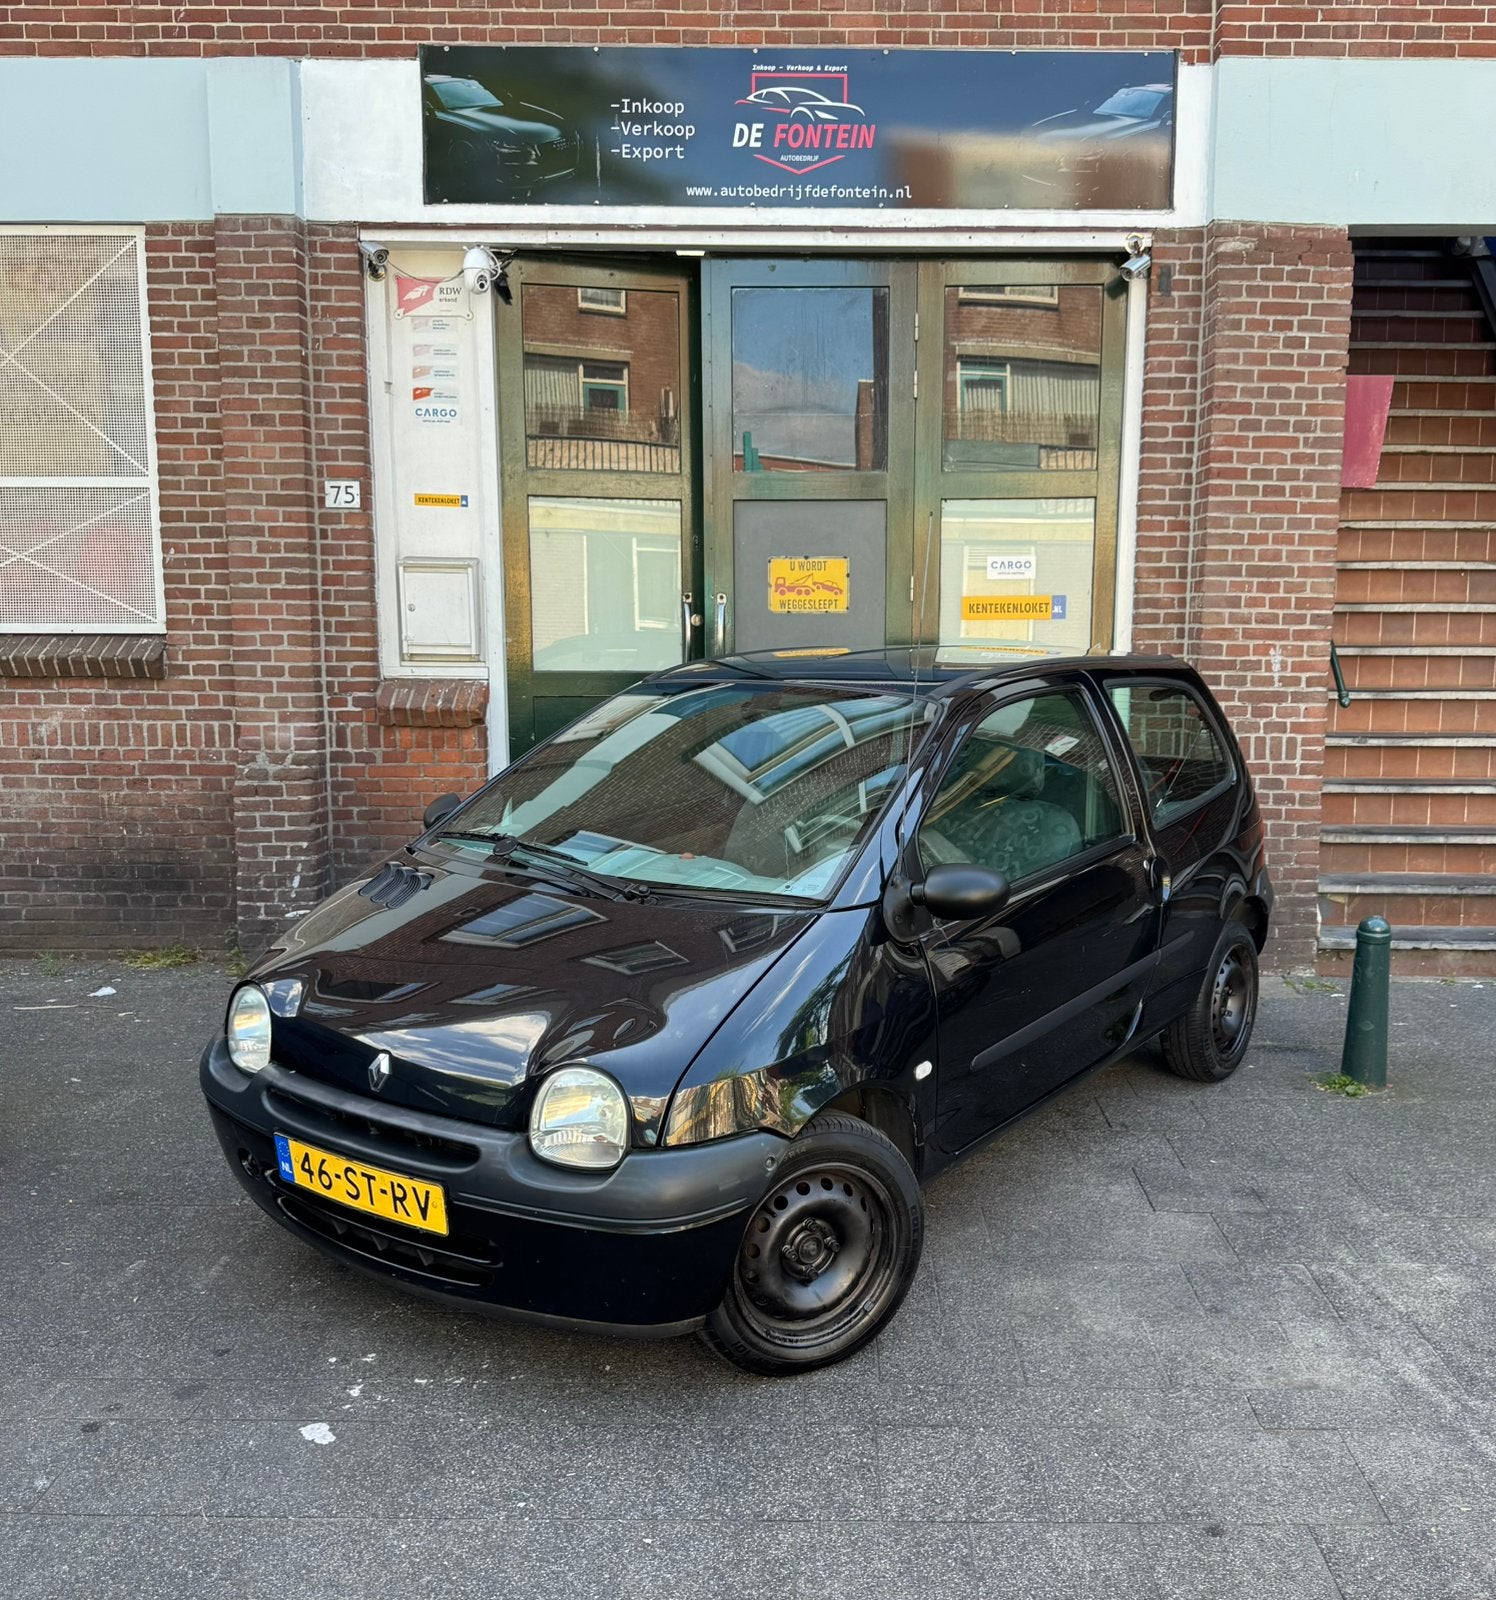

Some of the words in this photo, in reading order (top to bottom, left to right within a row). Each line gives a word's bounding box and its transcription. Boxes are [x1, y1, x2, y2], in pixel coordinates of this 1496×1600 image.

[752, 64, 776, 72] Inkoop
[786, 64, 814, 72] Verkoop
[732, 123, 765, 148] DE
[773, 123, 876, 149] FONTEIN
[686, 184, 912, 200] www.autobedrijfdefontein.nl
[439, 287, 462, 295] RDW
[415, 408, 458, 418] CARGO
[330, 485, 355, 504] 75
[790, 560, 796, 572] U
[798, 560, 828, 572] WORDT
[990, 560, 1032, 570] CARGO
[779, 599, 839, 610] WEGGESLEEPT
[281, 1161, 293, 1174] NL
[300, 1152, 430, 1222] 46-ST-RV
